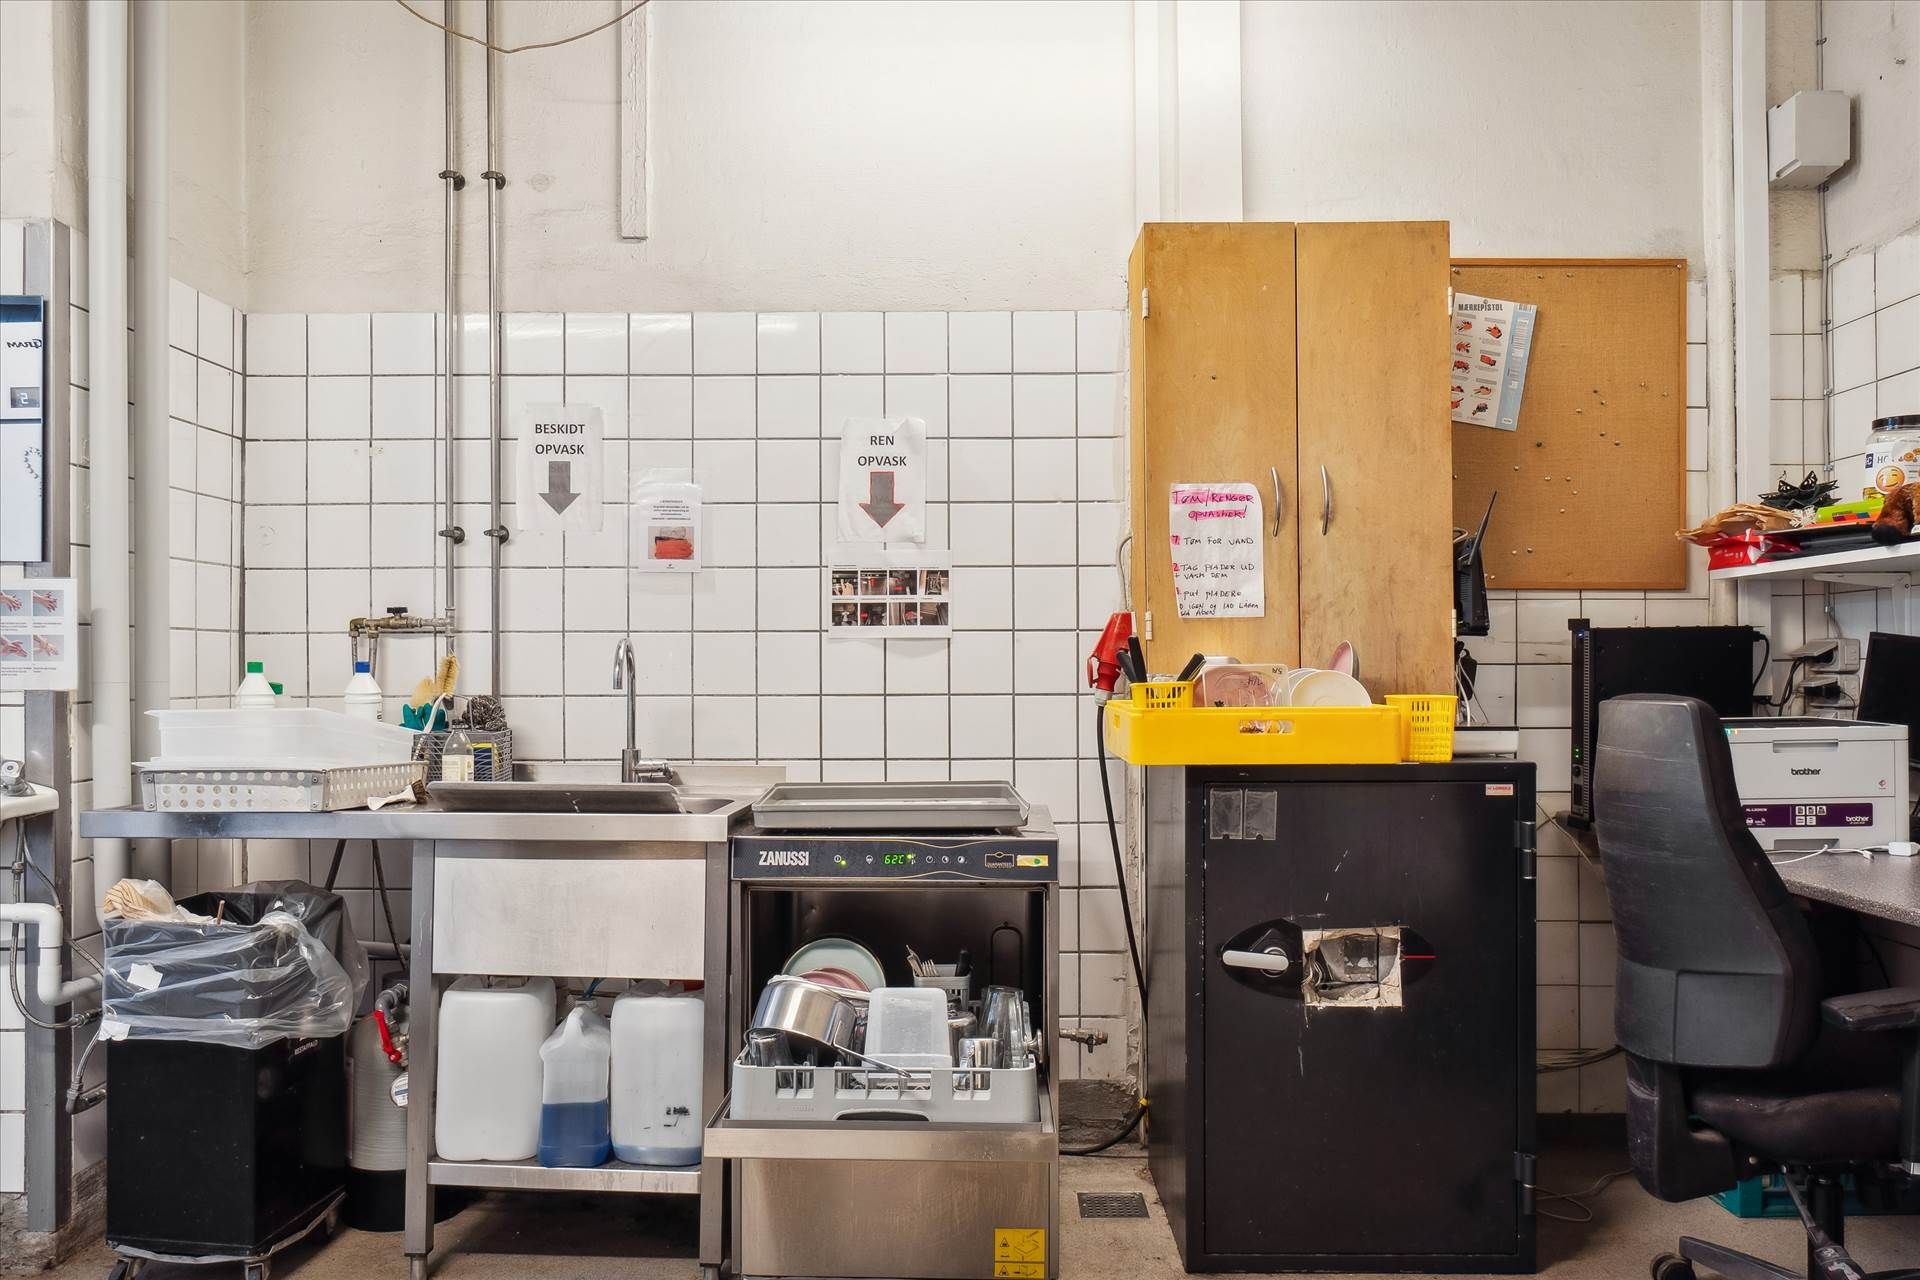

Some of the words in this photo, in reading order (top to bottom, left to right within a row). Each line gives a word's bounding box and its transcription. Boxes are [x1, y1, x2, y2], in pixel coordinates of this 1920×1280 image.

[1457, 303, 1503, 312] MÆRKEPISTOL
[534, 423, 586, 435] BESKIDT
[869, 435, 895, 446] REN
[534, 443, 585, 455] OPVASK
[857, 455, 907, 467] OPVASK
[1207, 536, 1222, 546] FOR
[1228, 537, 1254, 546] VAND
[1180, 564, 1199, 572] TAG
[1790, 767, 1822, 776] brother
[758, 850, 810, 866] ZANUSSI
